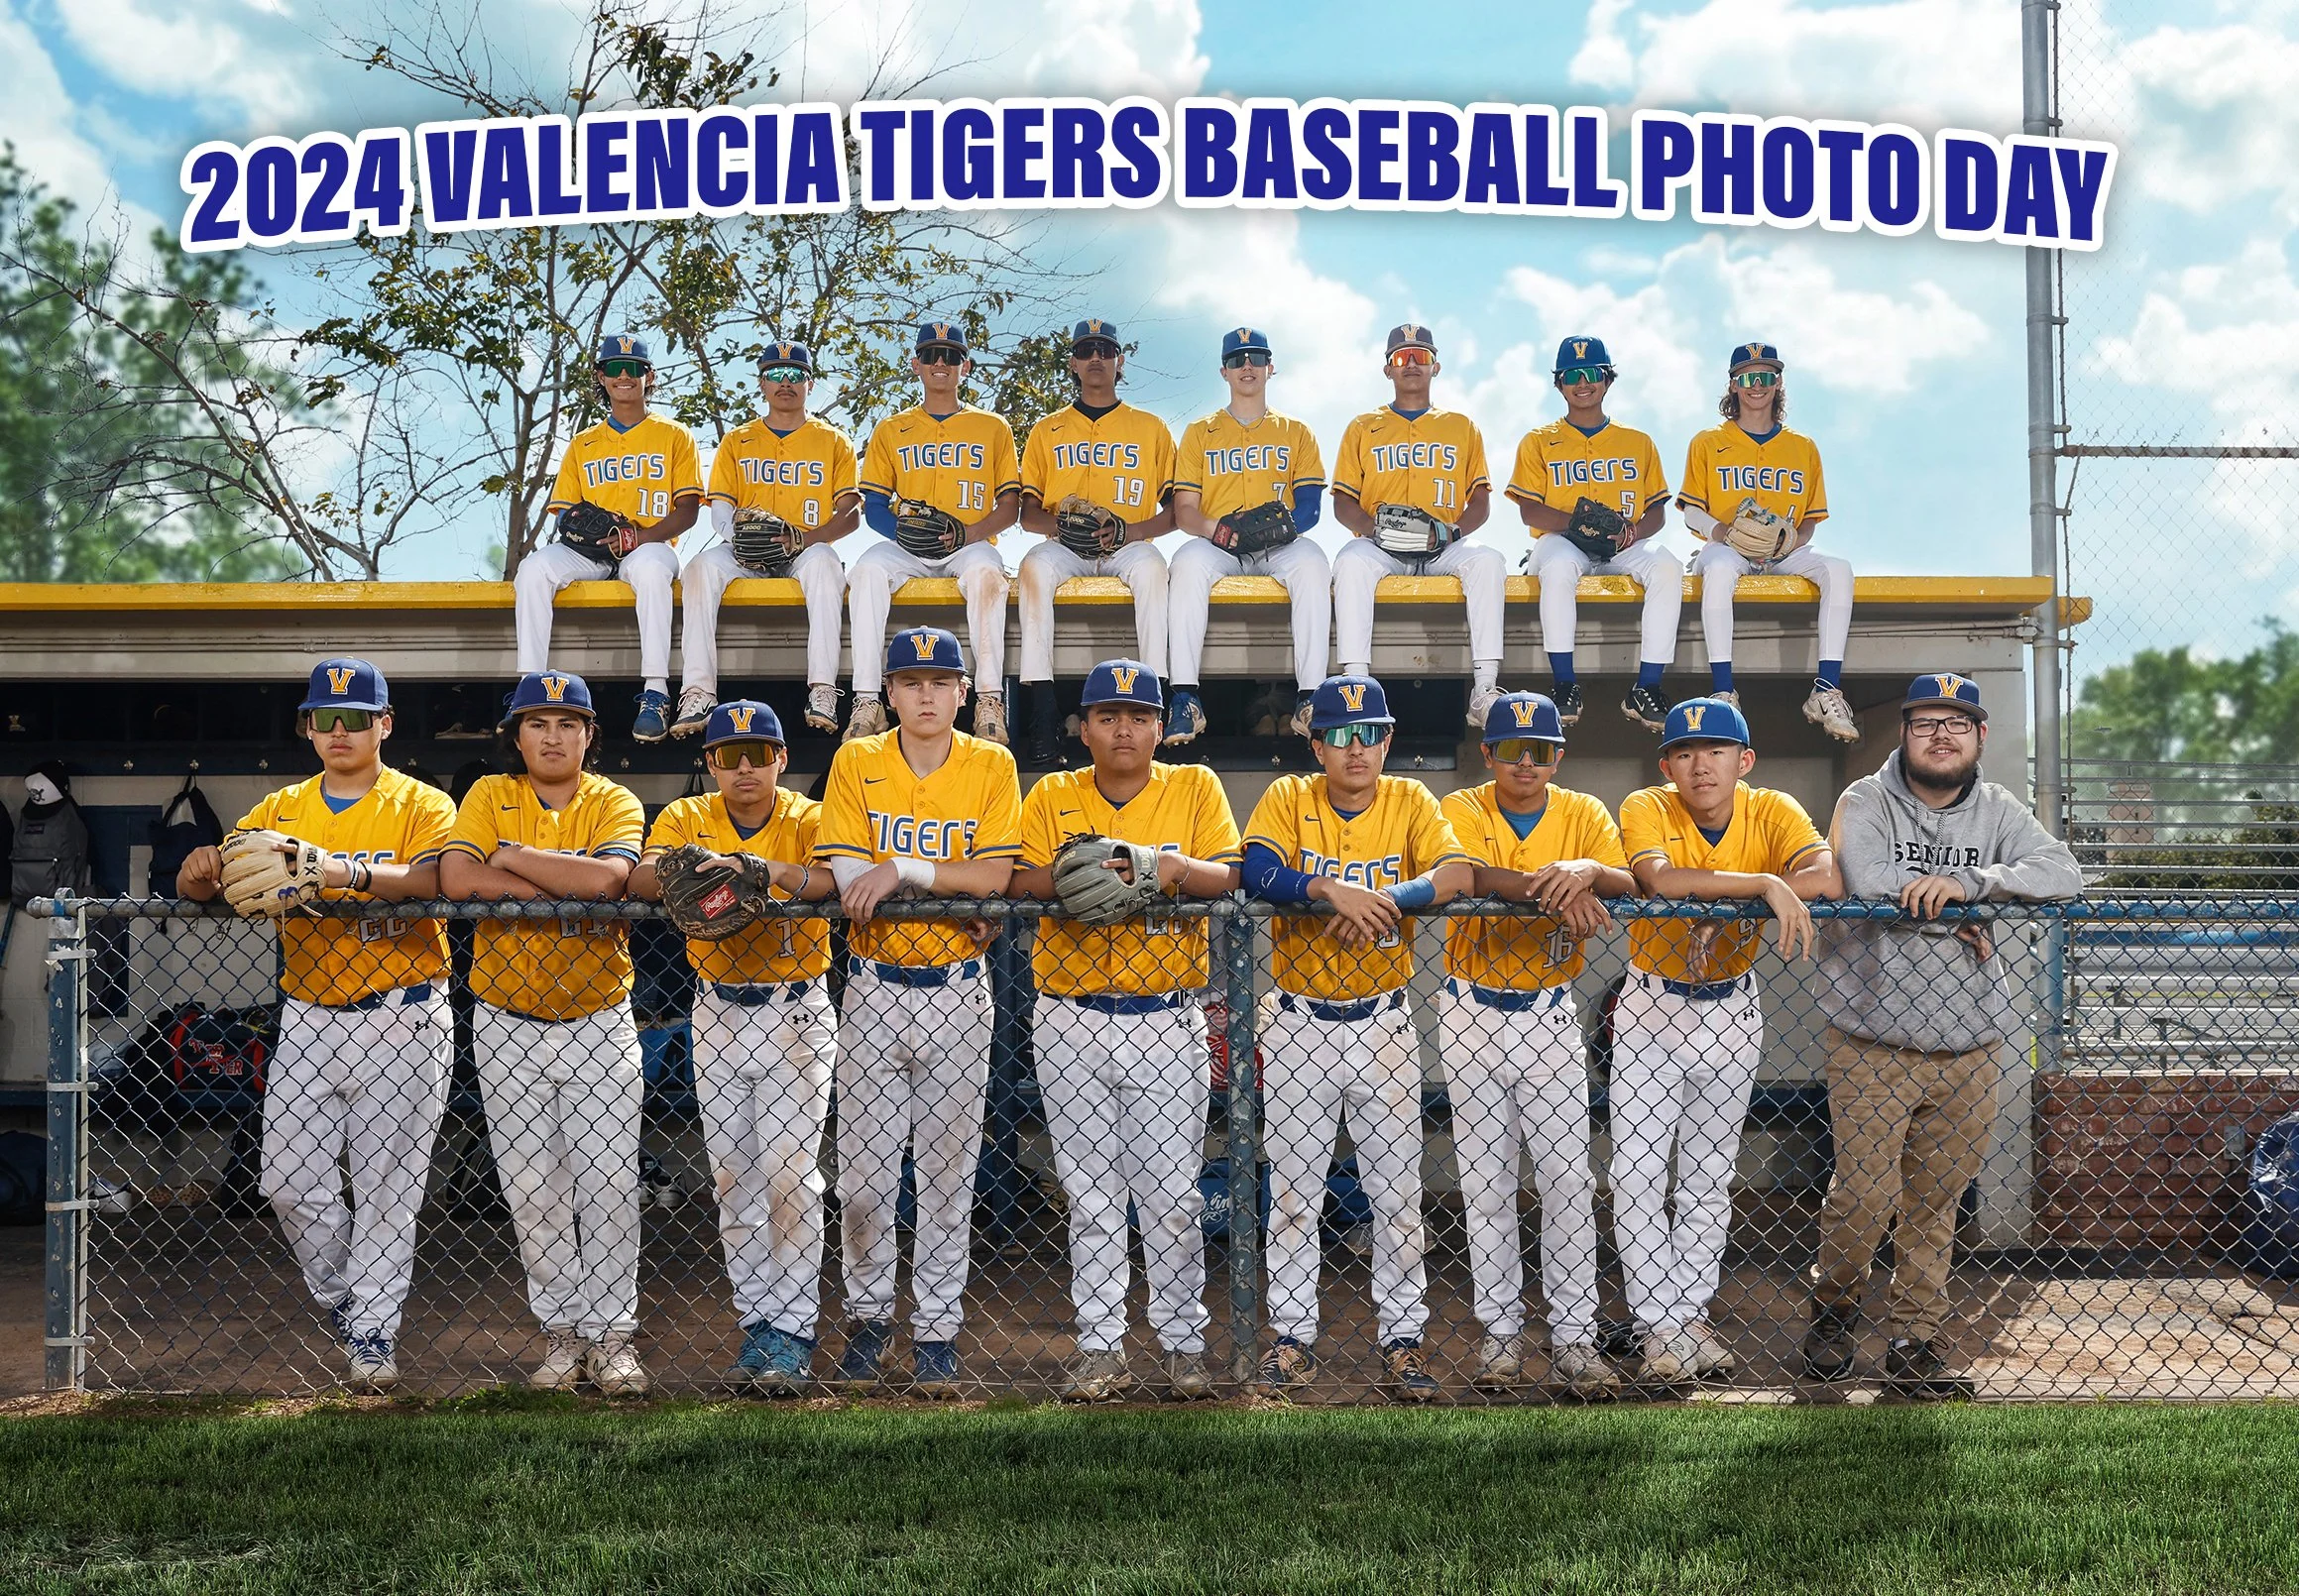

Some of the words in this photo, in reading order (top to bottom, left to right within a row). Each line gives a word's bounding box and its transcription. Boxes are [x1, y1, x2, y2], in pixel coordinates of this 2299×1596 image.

[933, 323, 951, 339] V
[1087, 318, 1102, 333] V
[1236, 328, 1252, 344] V
[1400, 324, 1420, 341] V
[617, 336, 635, 354] V
[776, 342, 794, 359] V
[1572, 342, 1588, 359] V
[1746, 343, 1765, 360] V
[897, 441, 985, 472] TIGERS
[1053, 441, 1140, 470] TIGERS
[1205, 444, 1290, 476] TIGERS
[1372, 442, 1456, 472] TIGERS
[583, 453, 665, 487] TIGERS
[739, 458, 824, 486] TIGERS
[1549, 457, 1639, 487] TIGERS
[1716, 465, 1804, 496] TIGERS
[635, 488, 669, 518] 18
[957, 480, 985, 511] 15
[1112, 476, 1144, 507] 19
[1272, 482, 1287, 503] 7
[1433, 478, 1455, 509] 11
[1620, 491, 1636, 518] 5
[803, 499, 820, 526] 8
[910, 634, 939, 660] V
[326, 667, 356, 694] V
[541, 676, 569, 702] V
[1110, 667, 1139, 694] V
[1935, 676, 1964, 699] V
[1338, 684, 1367, 712] V
[727, 707, 756, 734] V
[1510, 702, 1538, 728] V
[1683, 706, 1706, 732] V
[1895, 841, 1980, 867] SENIOR
[776, 918, 797, 959] 1
